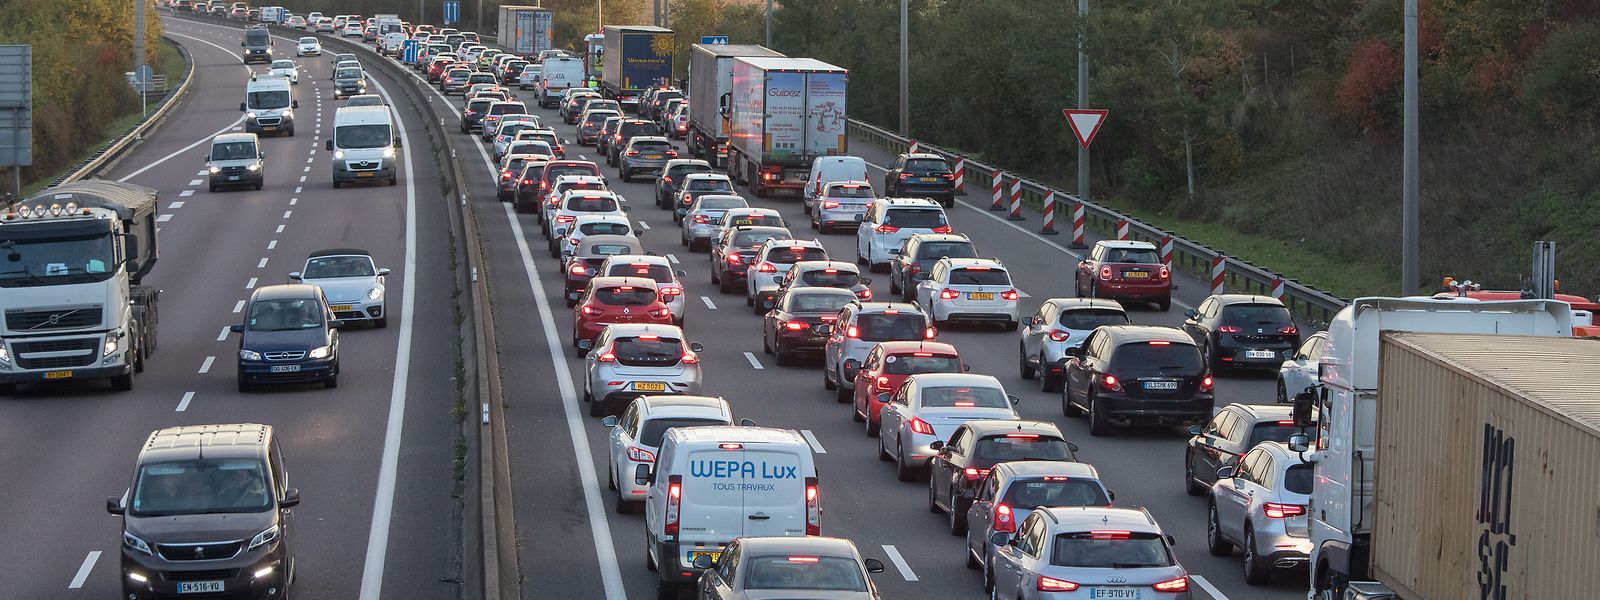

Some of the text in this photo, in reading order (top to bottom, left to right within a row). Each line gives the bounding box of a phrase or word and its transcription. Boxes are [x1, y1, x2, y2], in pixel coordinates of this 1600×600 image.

[690, 460, 797, 479] WEPA Lux
[713, 482, 775, 491] TOUS TRAVAUX
